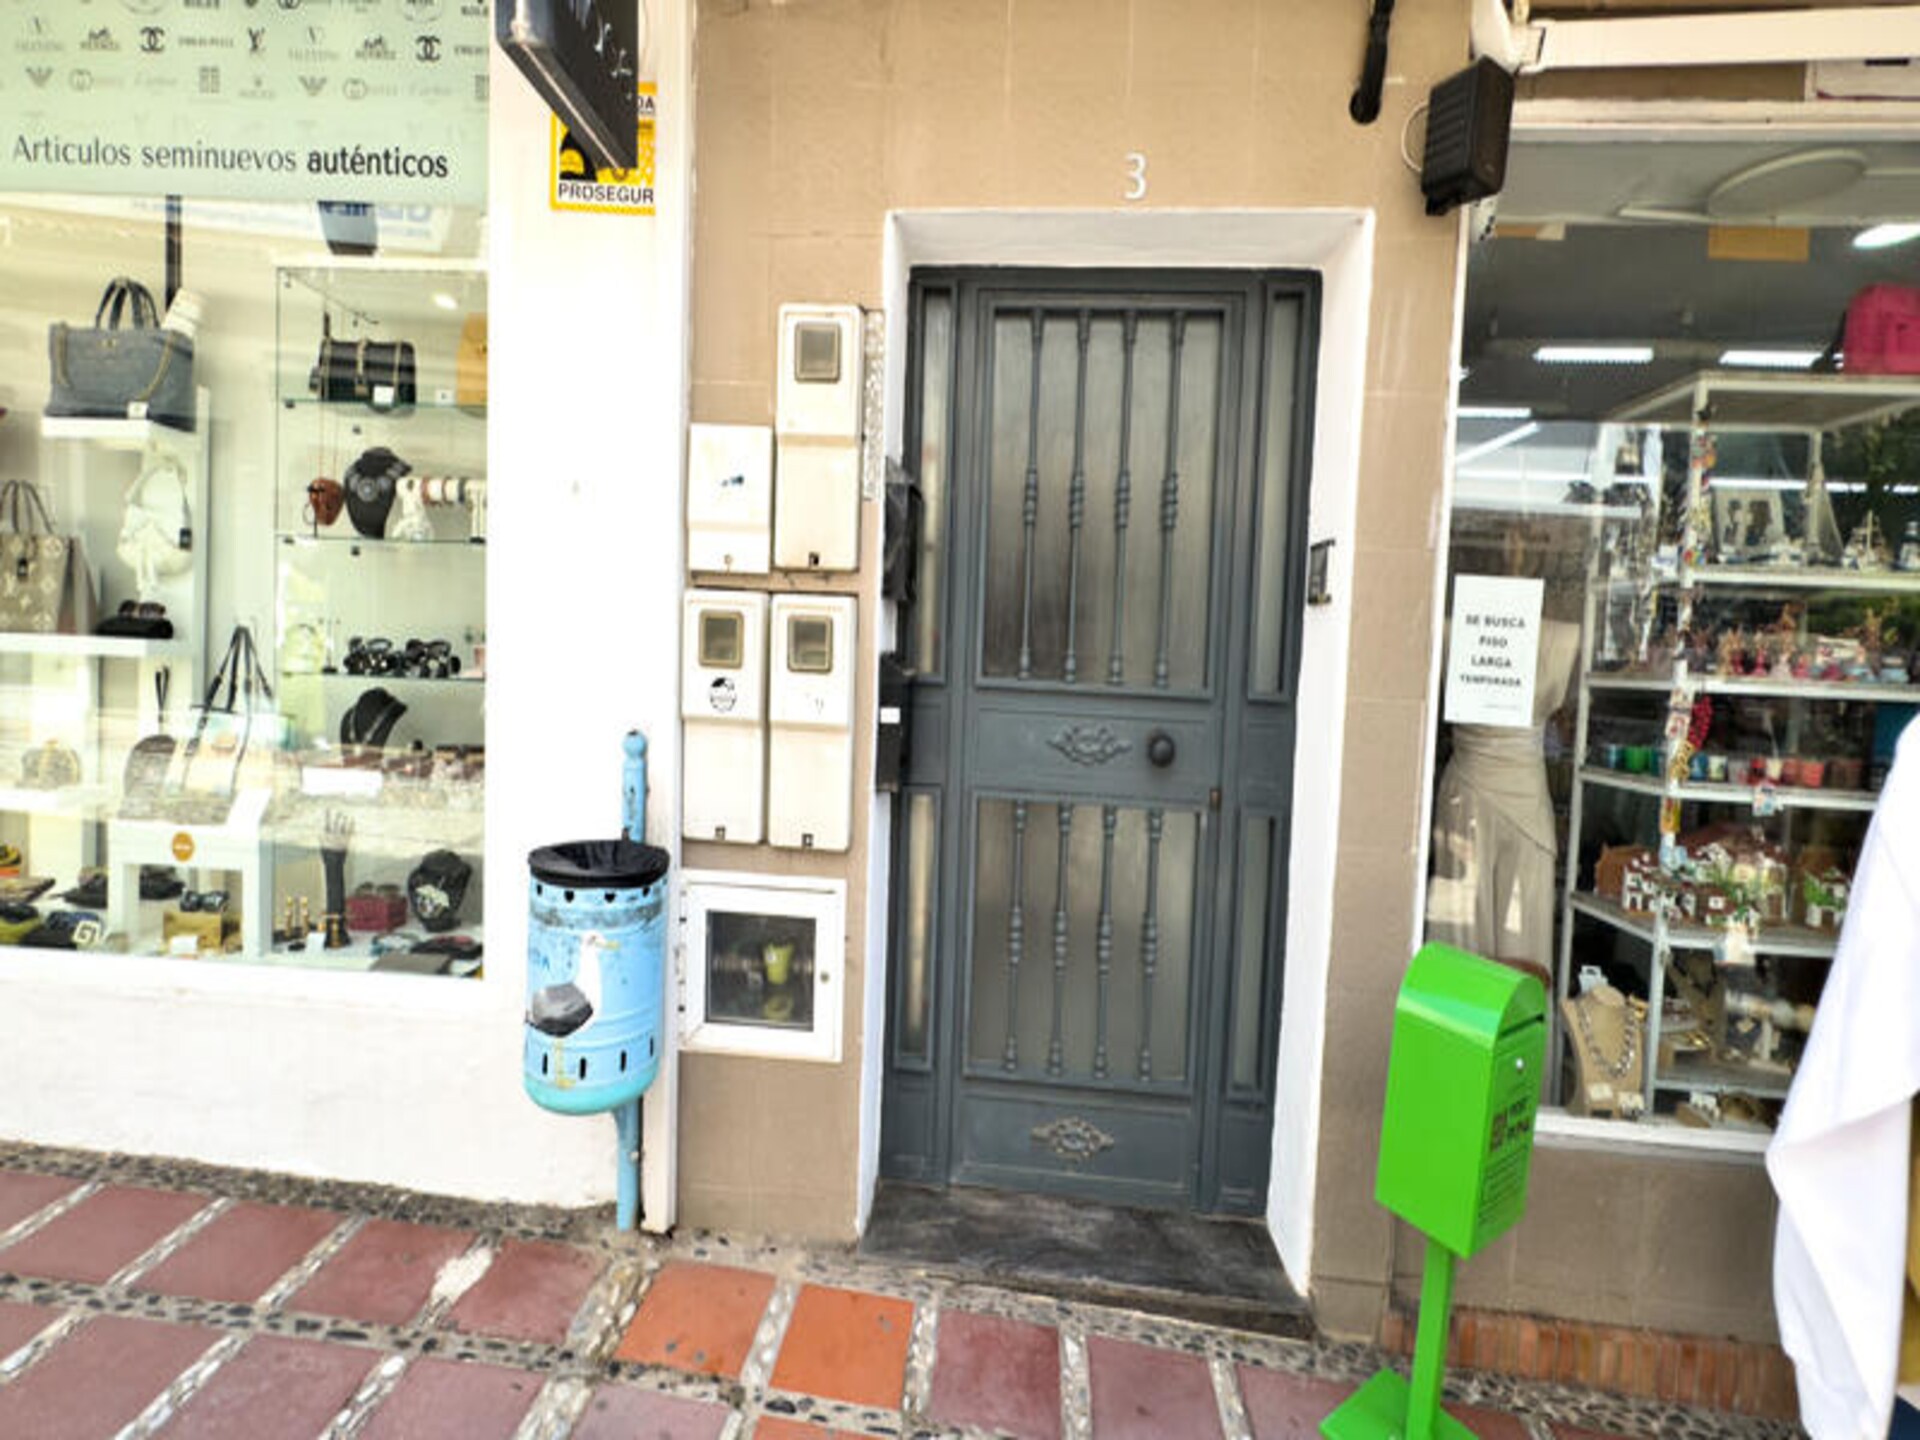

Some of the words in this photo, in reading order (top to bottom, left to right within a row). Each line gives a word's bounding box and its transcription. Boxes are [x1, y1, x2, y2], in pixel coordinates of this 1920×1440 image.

[141, 140, 297, 173] seminuevos
[307, 143, 449, 178] auténticos
[1125, 152, 1146, 199] 3
[558, 183, 654, 204] PROSEGUR
[1466, 614, 1480, 625] SE
[1484, 615, 1525, 628] BUSCA
[1479, 635, 1508, 648] PISO
[1471, 656, 1512, 668] LARGA
[1460, 674, 1521, 687] TEMPORADA
